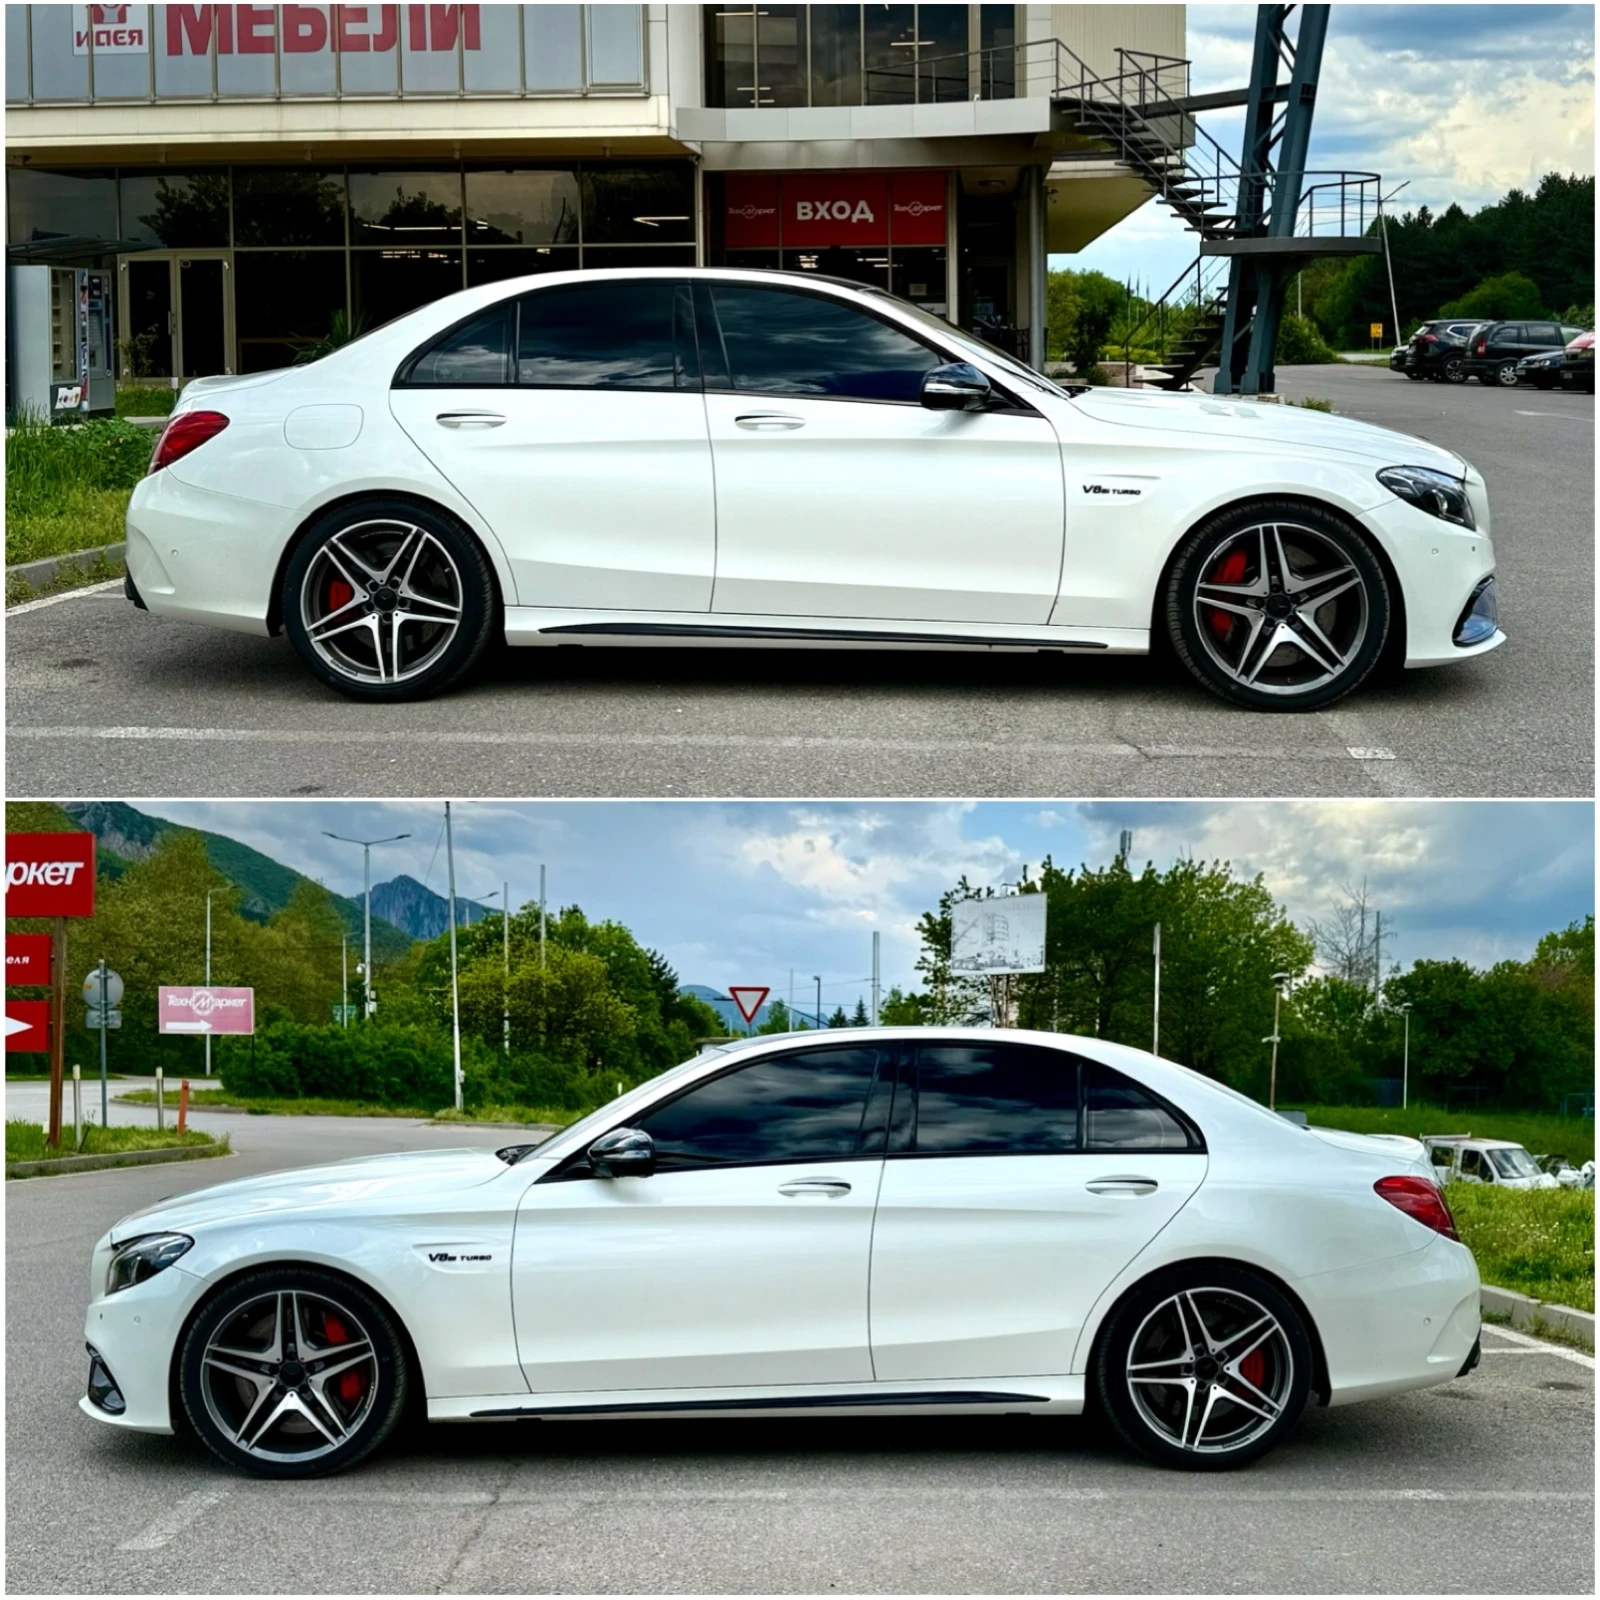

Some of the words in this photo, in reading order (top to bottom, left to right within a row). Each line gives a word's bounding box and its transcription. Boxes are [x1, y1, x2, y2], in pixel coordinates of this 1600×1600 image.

[166, 4, 481, 56] МЕБЕЛИ
[796, 200, 874, 223] ВХОД
[5, 861, 84, 893] ркет
